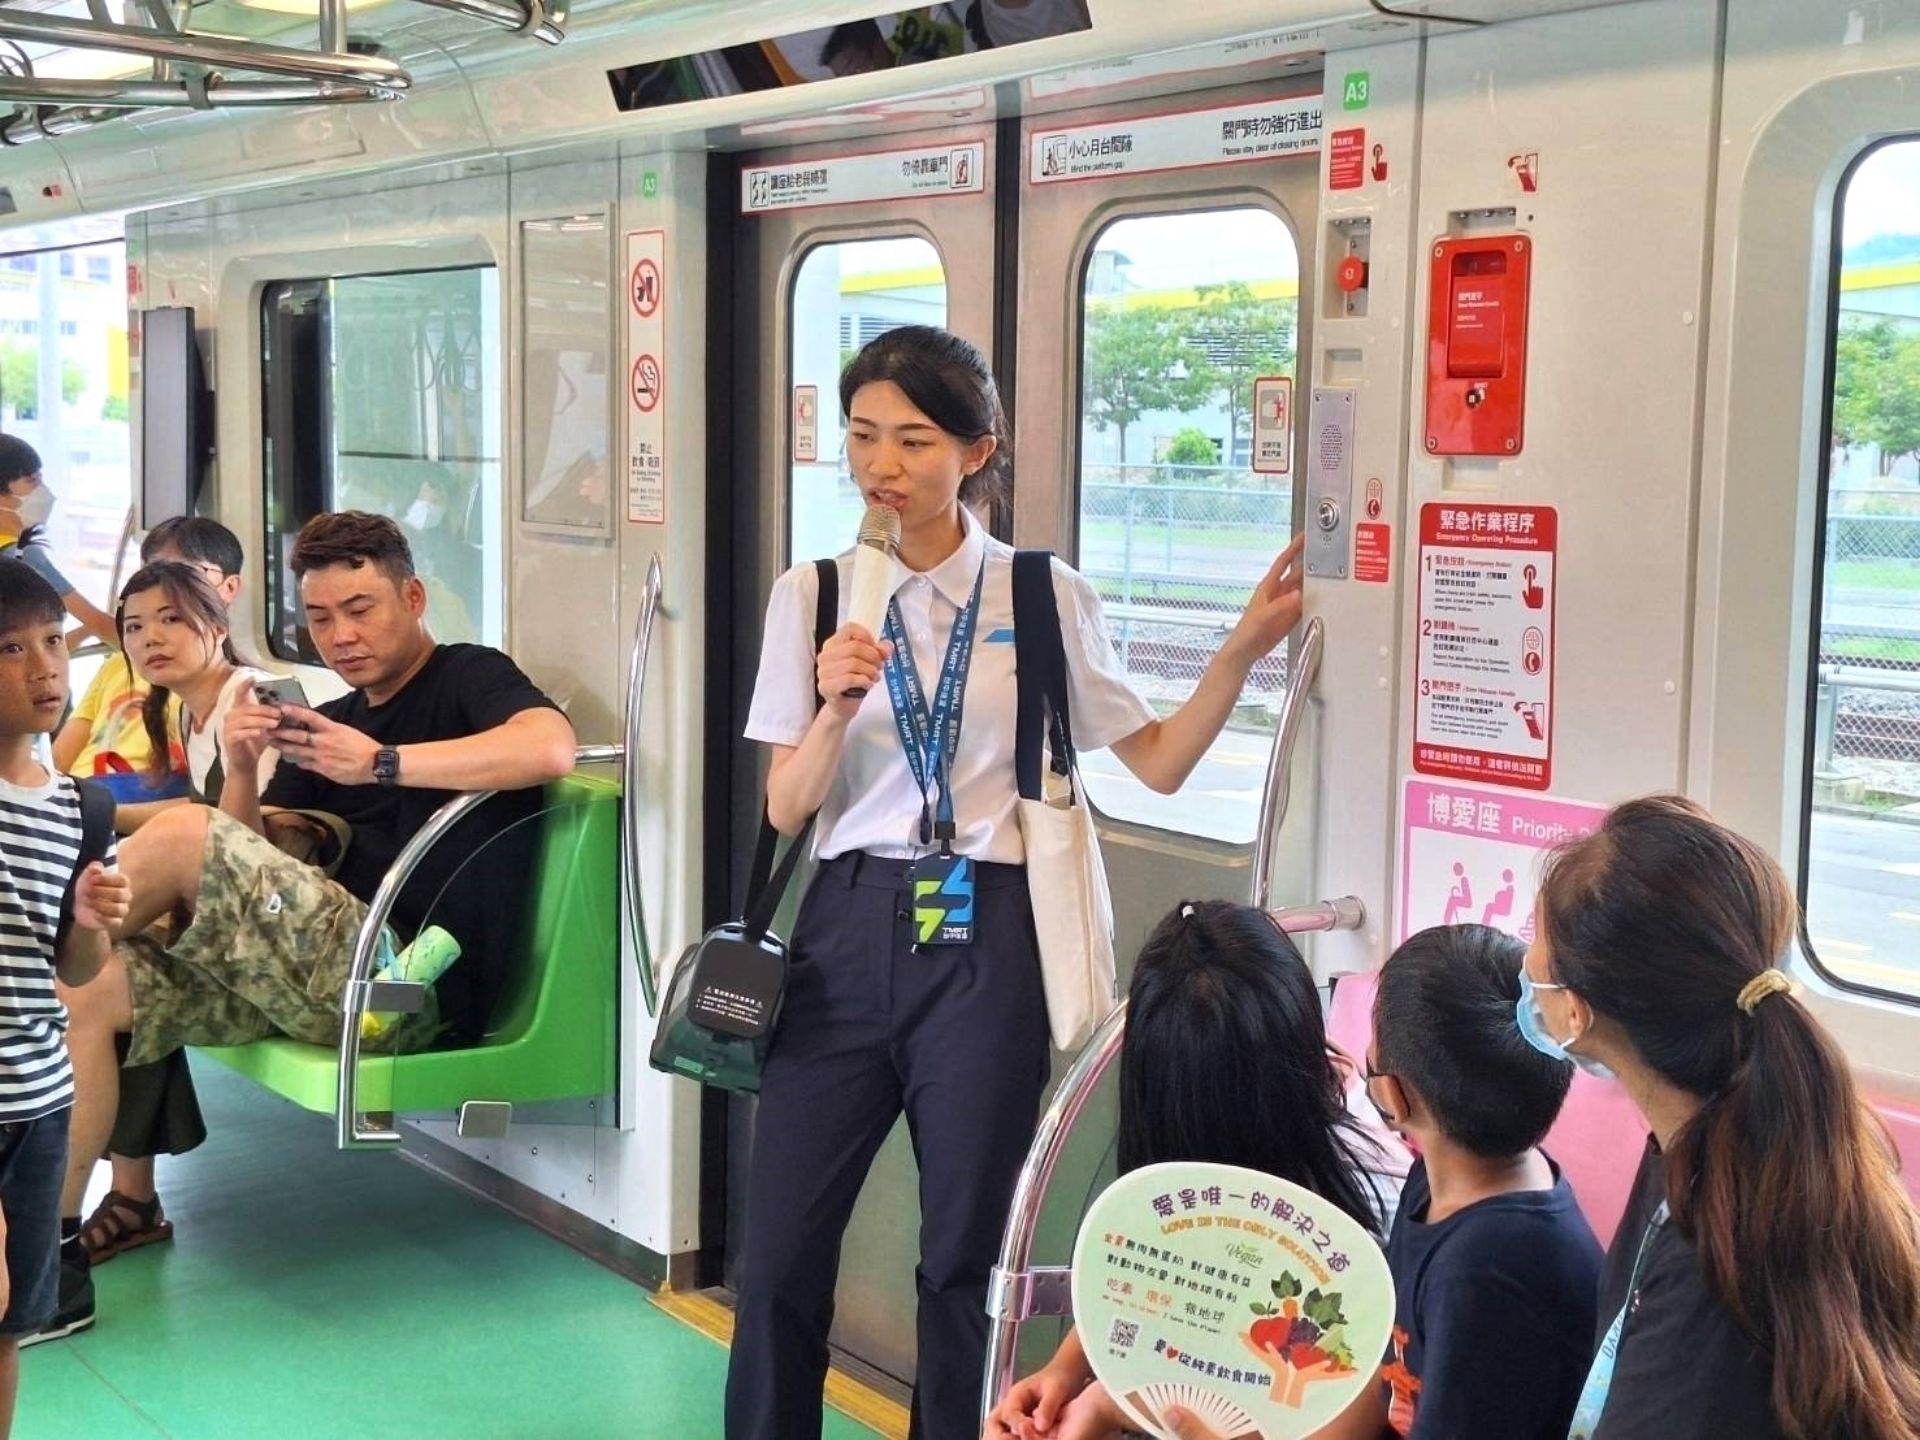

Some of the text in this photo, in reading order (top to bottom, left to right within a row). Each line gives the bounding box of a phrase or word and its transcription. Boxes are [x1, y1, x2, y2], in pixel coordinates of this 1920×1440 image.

[1346, 81, 1367, 102] A3
[1069, 134, 1133, 160] 小心月台間隙
[1440, 510, 1535, 533] 緊急作業程序
[1436, 532, 1538, 544] Emergency Operating Procedure
[1425, 554, 1432, 572] 1
[1423, 619, 1432, 636] 2
[948, 641, 961, 672] TMRT
[1421, 679, 1430, 696] 3
[900, 713, 913, 745] TMRT
[932, 713, 944, 746] TMRT
[1428, 792, 1502, 834] 博愛座
[1152, 1185, 1350, 1272] 愛是唯一的解決之道
[1161, 1216, 1330, 1285] LOVE IS THE ONLY SOLUTION
[1225, 1242, 1264, 1268] Vegan
[1107, 1253, 1238, 1303] 對動物友愛 對地球有利
[1191, 1260, 1251, 1288] 對健康有益
[1107, 1278, 1133, 1295] 吃素
[1146, 1289, 1173, 1306] 環保
[1185, 1301, 1226, 1324] 救地球
